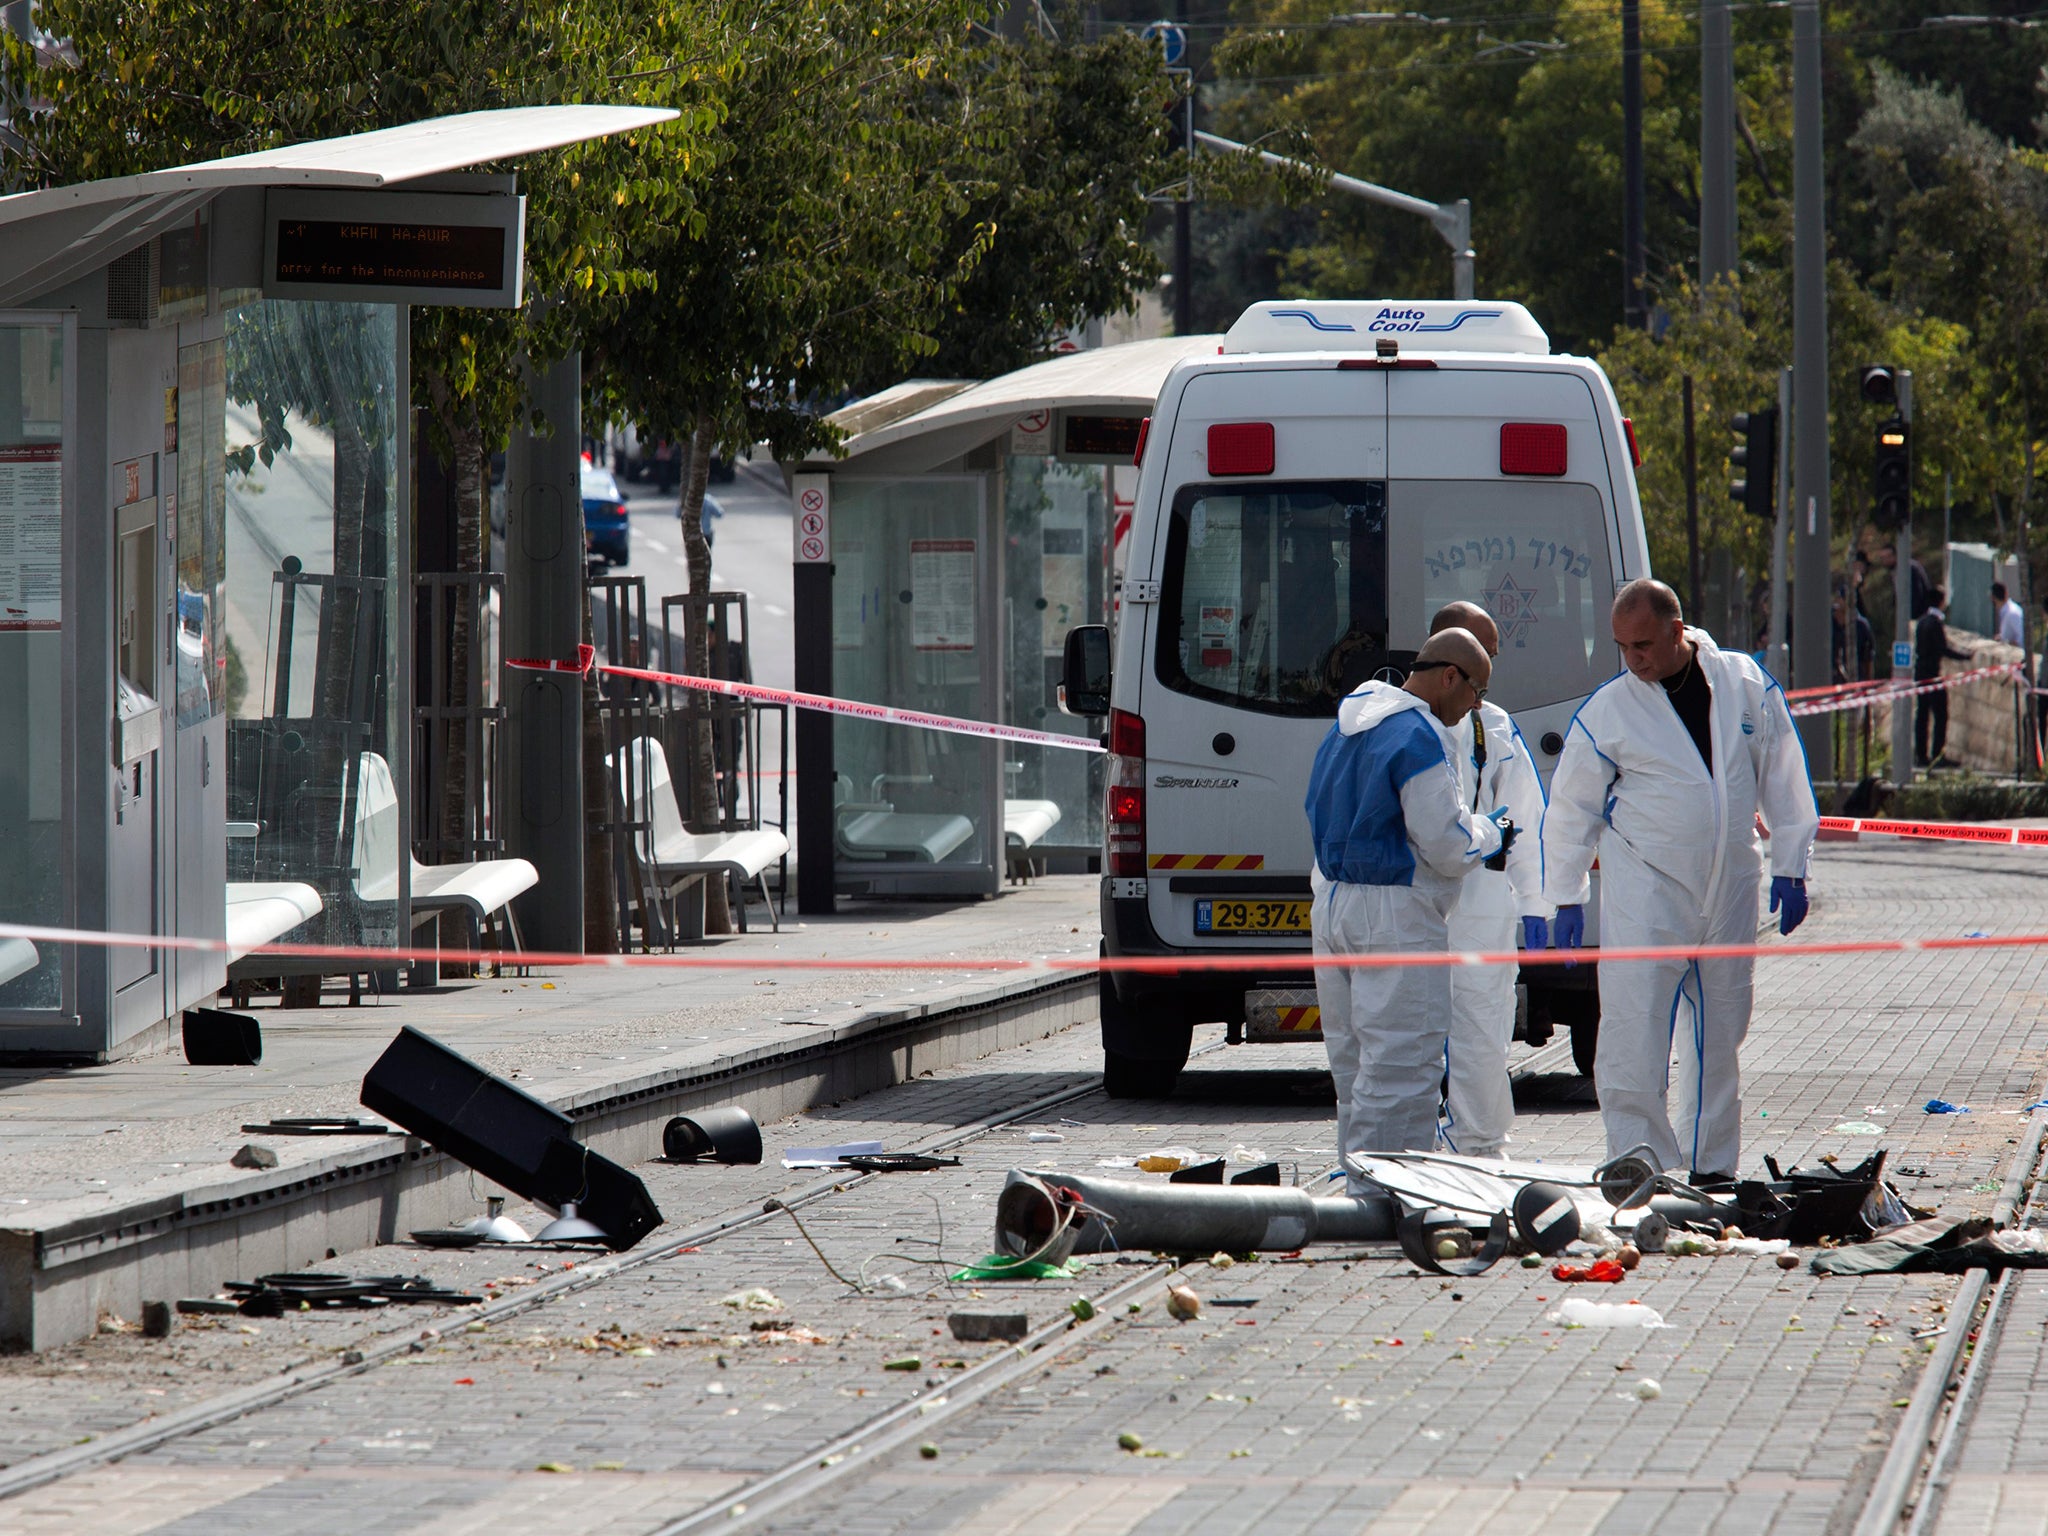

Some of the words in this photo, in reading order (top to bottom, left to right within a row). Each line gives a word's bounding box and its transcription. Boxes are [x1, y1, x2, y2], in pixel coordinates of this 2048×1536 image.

[1376, 308, 1425, 320] Auto
[1368, 320, 1420, 332] Cool
[1425, 536, 1516, 578] ומרפא
[1154, 776, 1239, 788] SPRINTER
